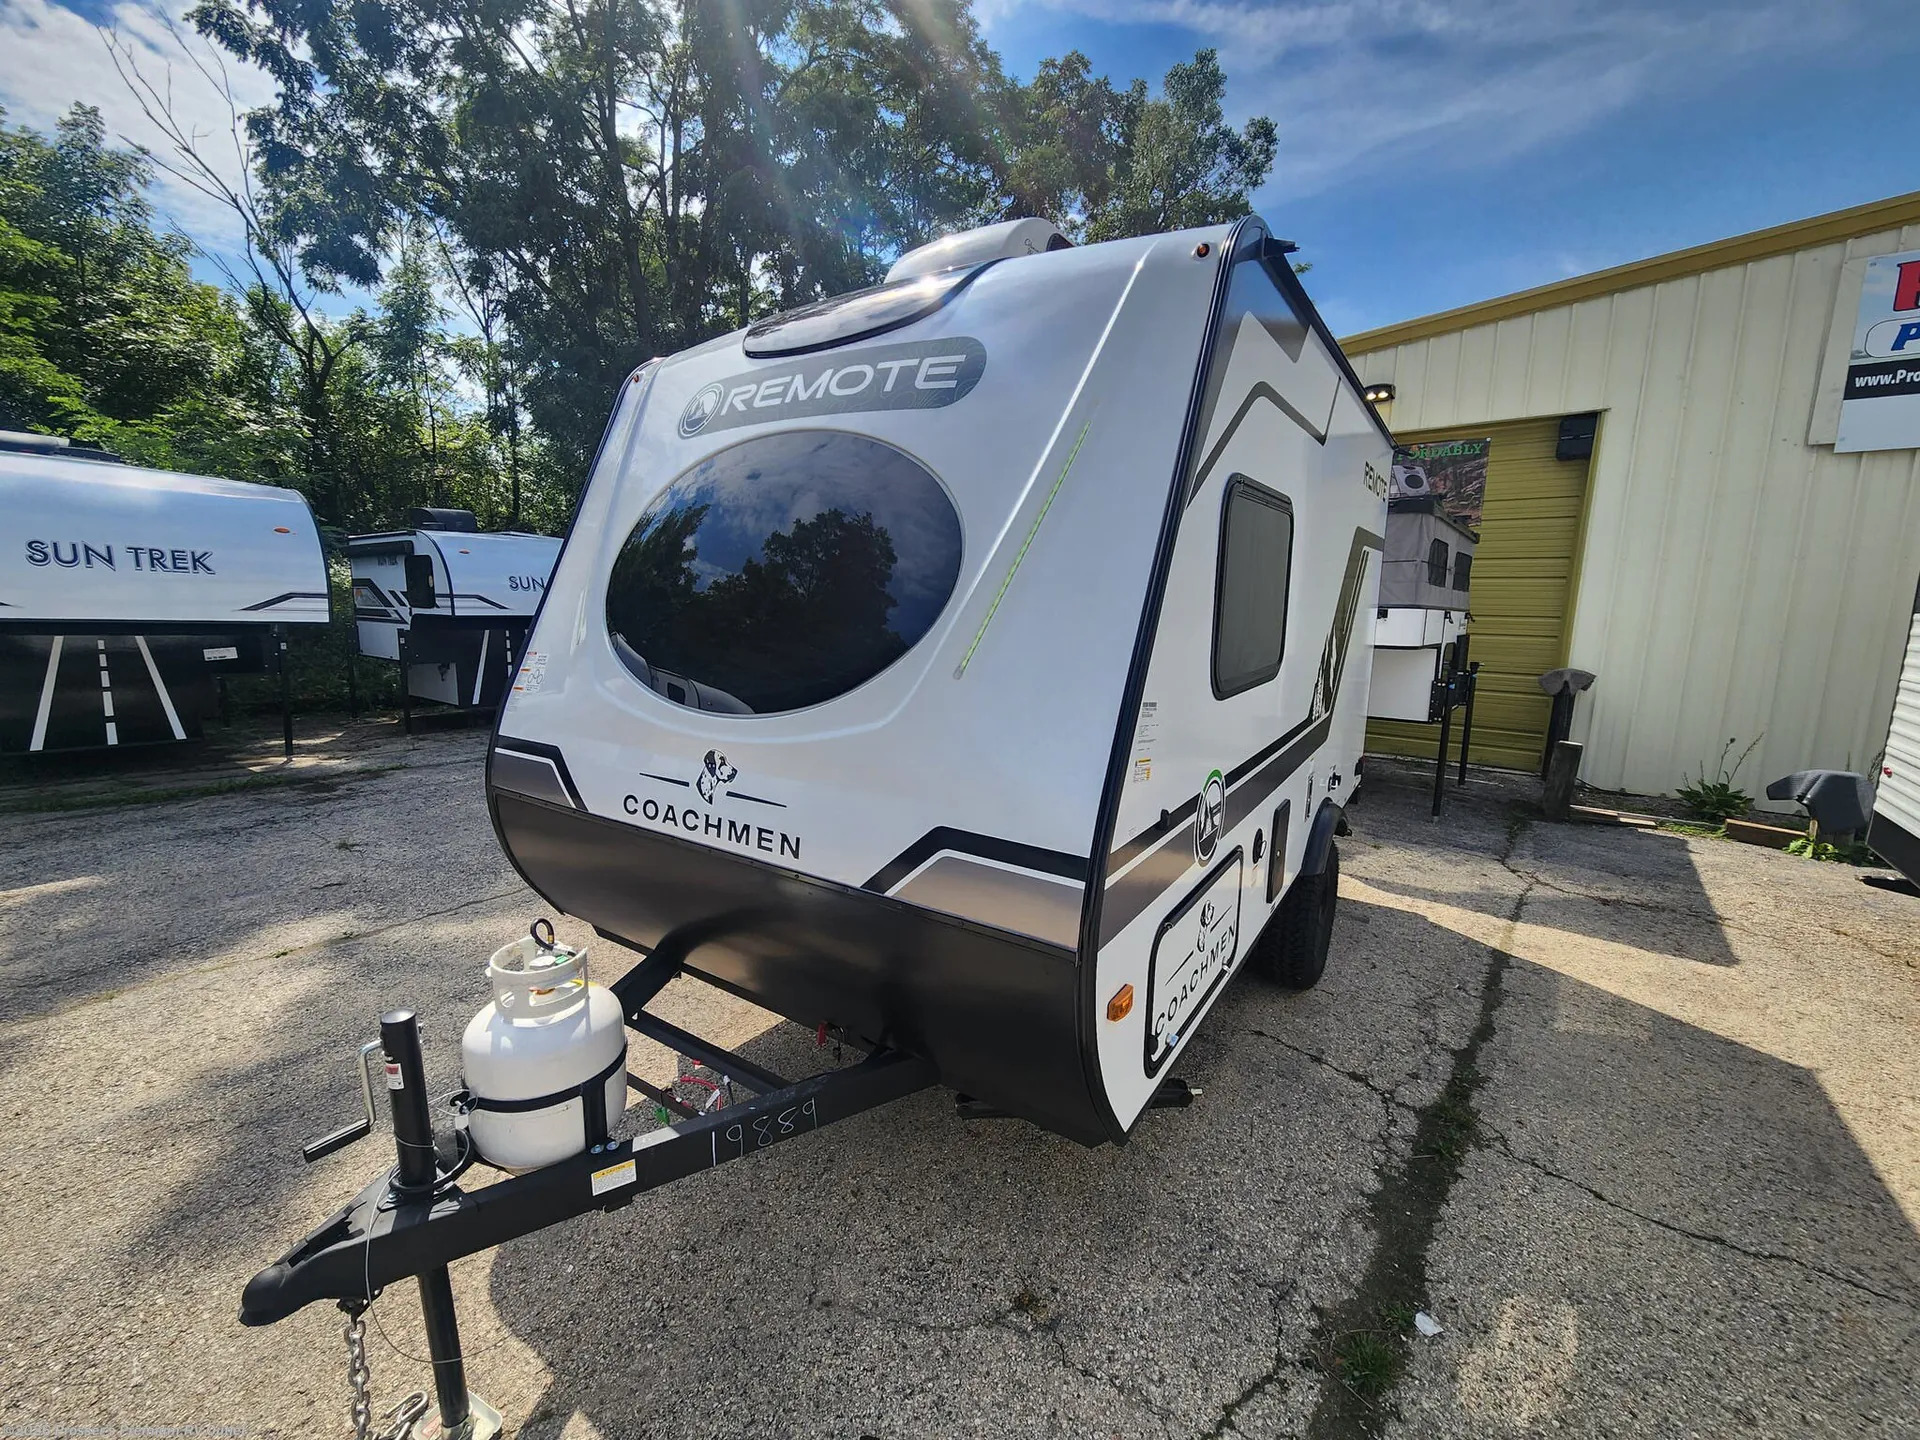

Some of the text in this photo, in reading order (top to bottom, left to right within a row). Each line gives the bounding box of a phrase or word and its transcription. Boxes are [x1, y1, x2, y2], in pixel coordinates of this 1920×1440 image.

[720, 353, 967, 417] REMOTE
[1363, 460, 1388, 503] REMOTE
[25, 540, 216, 575] SUN TREK
[508, 575, 546, 592] SUN
[622, 793, 802, 860] COACHMEN
[1154, 920, 1236, 1039] COACHMEN
[712, 1096, 818, 1168] 19889
